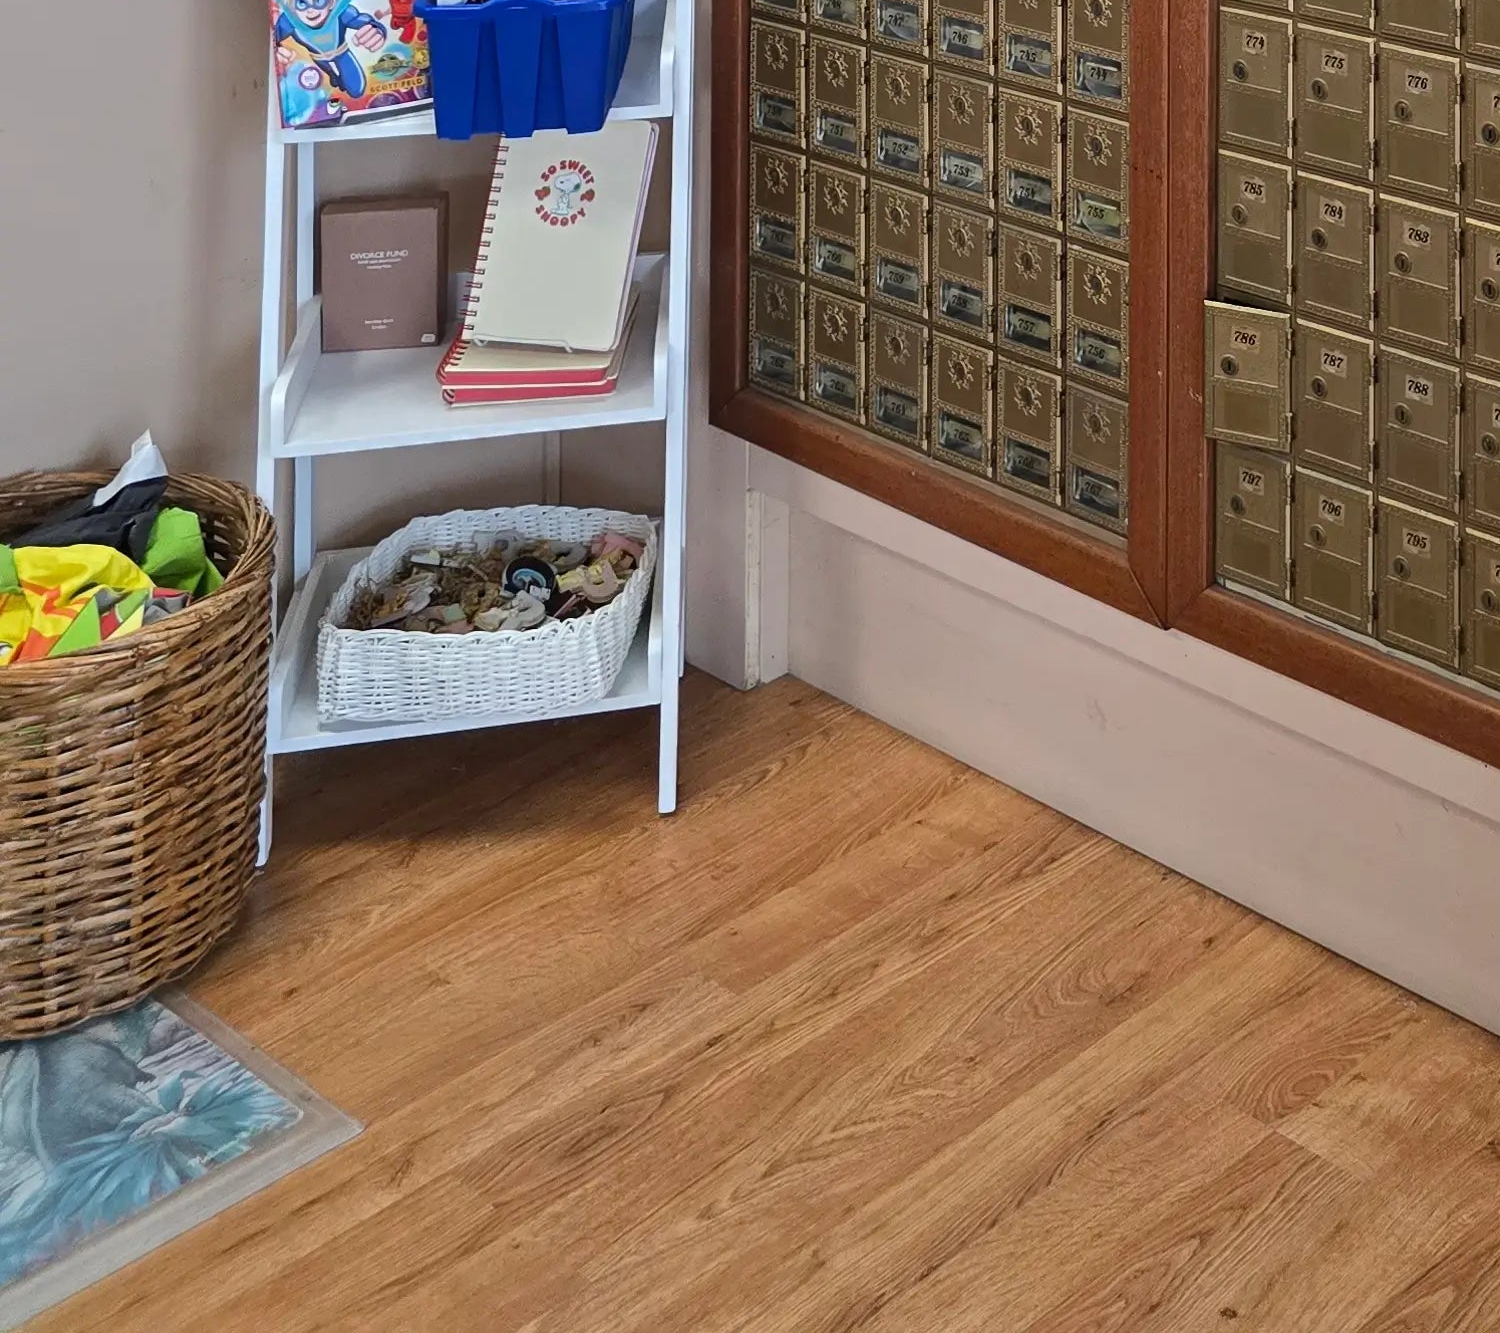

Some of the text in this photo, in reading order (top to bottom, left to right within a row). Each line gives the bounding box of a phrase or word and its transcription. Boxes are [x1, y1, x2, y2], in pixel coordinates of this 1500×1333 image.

[1245, 34, 1265, 49] 774
[1324, 54, 1345, 69] 775
[1407, 74, 1428, 89] 776
[541, 159, 594, 184] SO SWEET
[1243, 182, 1263, 197] 785
[535, 204, 586, 227] SNOOPY
[1323, 203, 1344, 219] 784
[1408, 228, 1429, 245] 783
[1234, 330, 1256, 348] 786
[1322, 353, 1344, 369] 787
[1407, 380, 1428, 396] 788
[1241, 472, 1262, 487] 797
[1321, 500, 1341, 517] 796
[1405, 532, 1427, 550] 795
